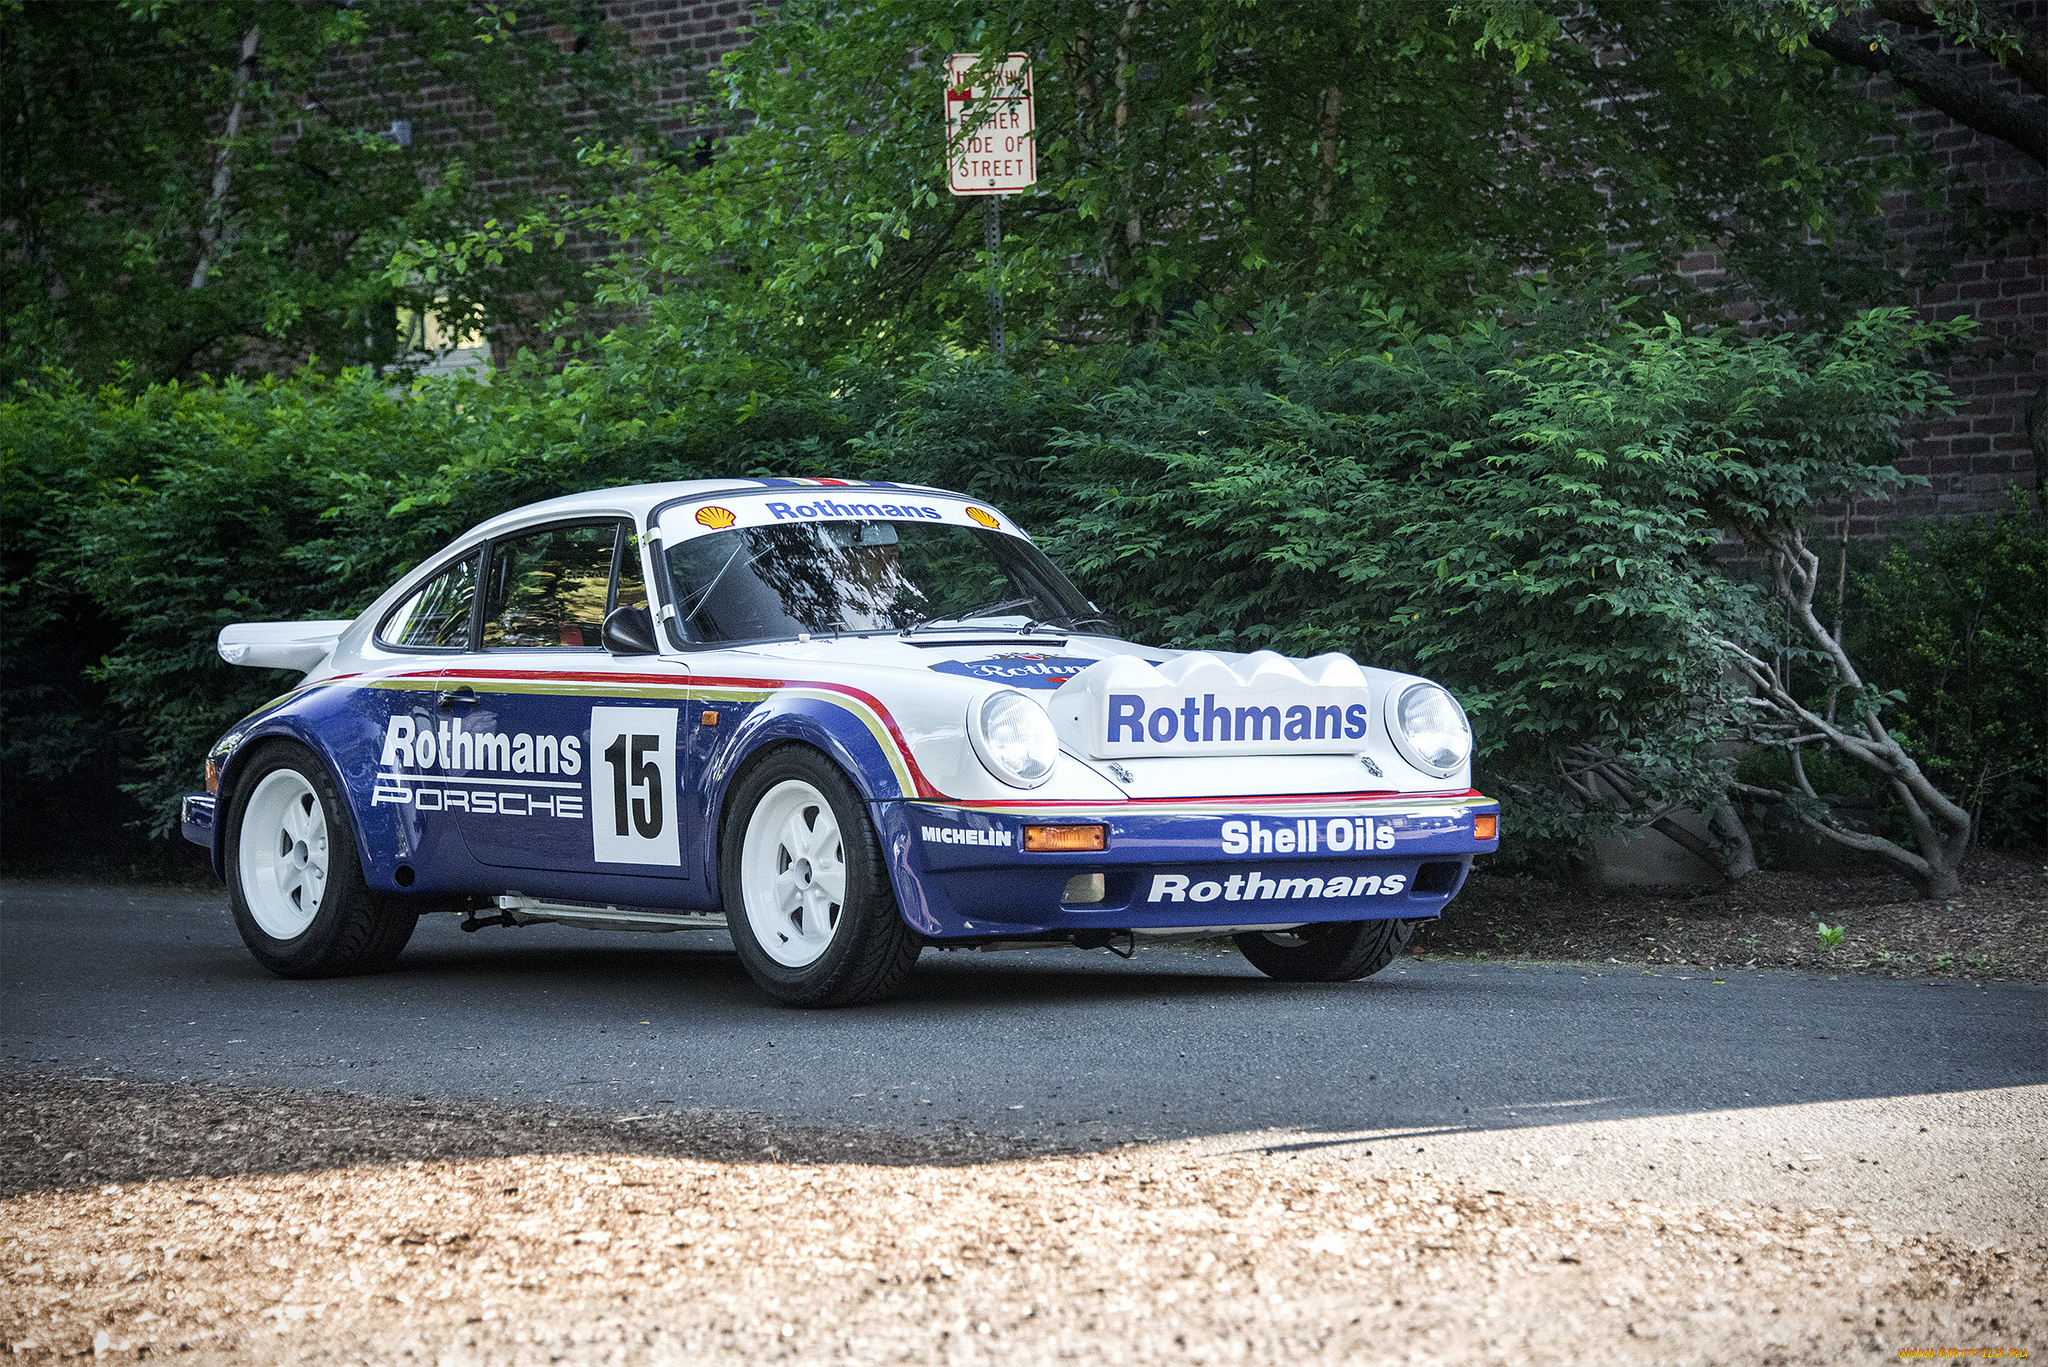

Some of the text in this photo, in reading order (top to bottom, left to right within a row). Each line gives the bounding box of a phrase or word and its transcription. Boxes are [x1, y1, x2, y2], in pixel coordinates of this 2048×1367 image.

[960, 113, 1020, 130] EHER
[1005, 136, 1024, 153] OF
[960, 159, 1024, 178] STREET
[765, 500, 942, 520] Rothmans
[1107, 694, 1367, 743] Rothmans
[380, 715, 582, 776] Rothmans
[604, 733, 664, 840] 15
[371, 786, 584, 819] PORSCHE
[921, 826, 1011, 846] MICHELIN
[1221, 817, 1396, 854] Shell Oils
[1147, 872, 1407, 903] Rothmans
